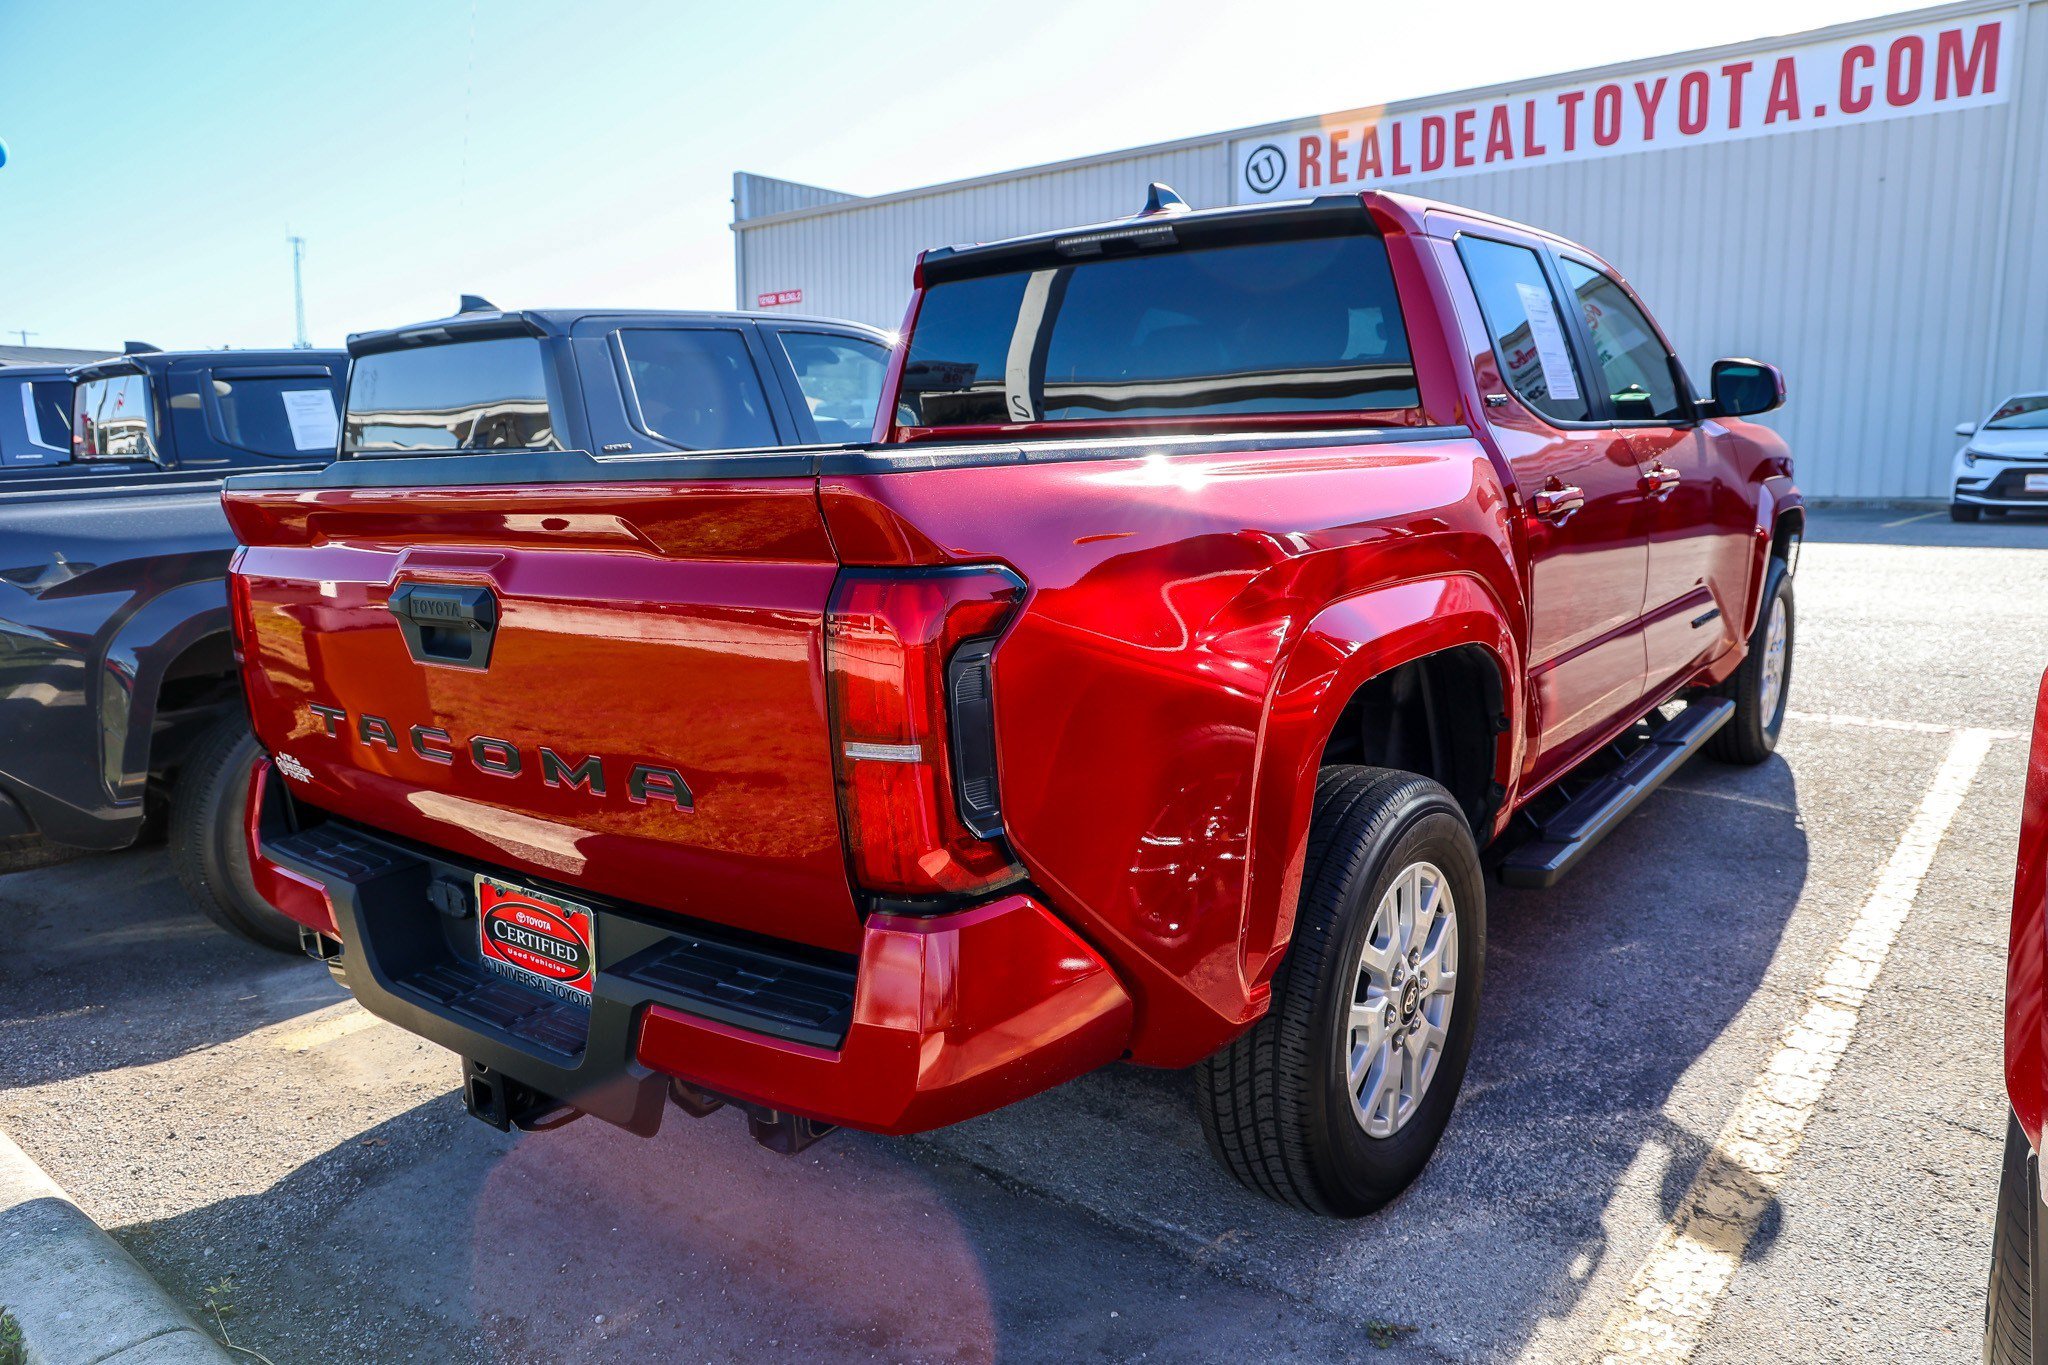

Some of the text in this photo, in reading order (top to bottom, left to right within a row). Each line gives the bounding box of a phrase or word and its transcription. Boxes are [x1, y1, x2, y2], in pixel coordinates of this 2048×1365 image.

[1299, 22, 2001, 189] REALDEALTOYOTA.COM
[413, 600, 460, 617] TOYOTA
[307, 700, 694, 813] TACOMA
[525, 915, 551, 931] TOYOTA
[507, 947, 566, 973] Used Vehicles
[492, 960, 552, 994] UNIVERSAL
[552, 983, 593, 1008] TOYOTA
